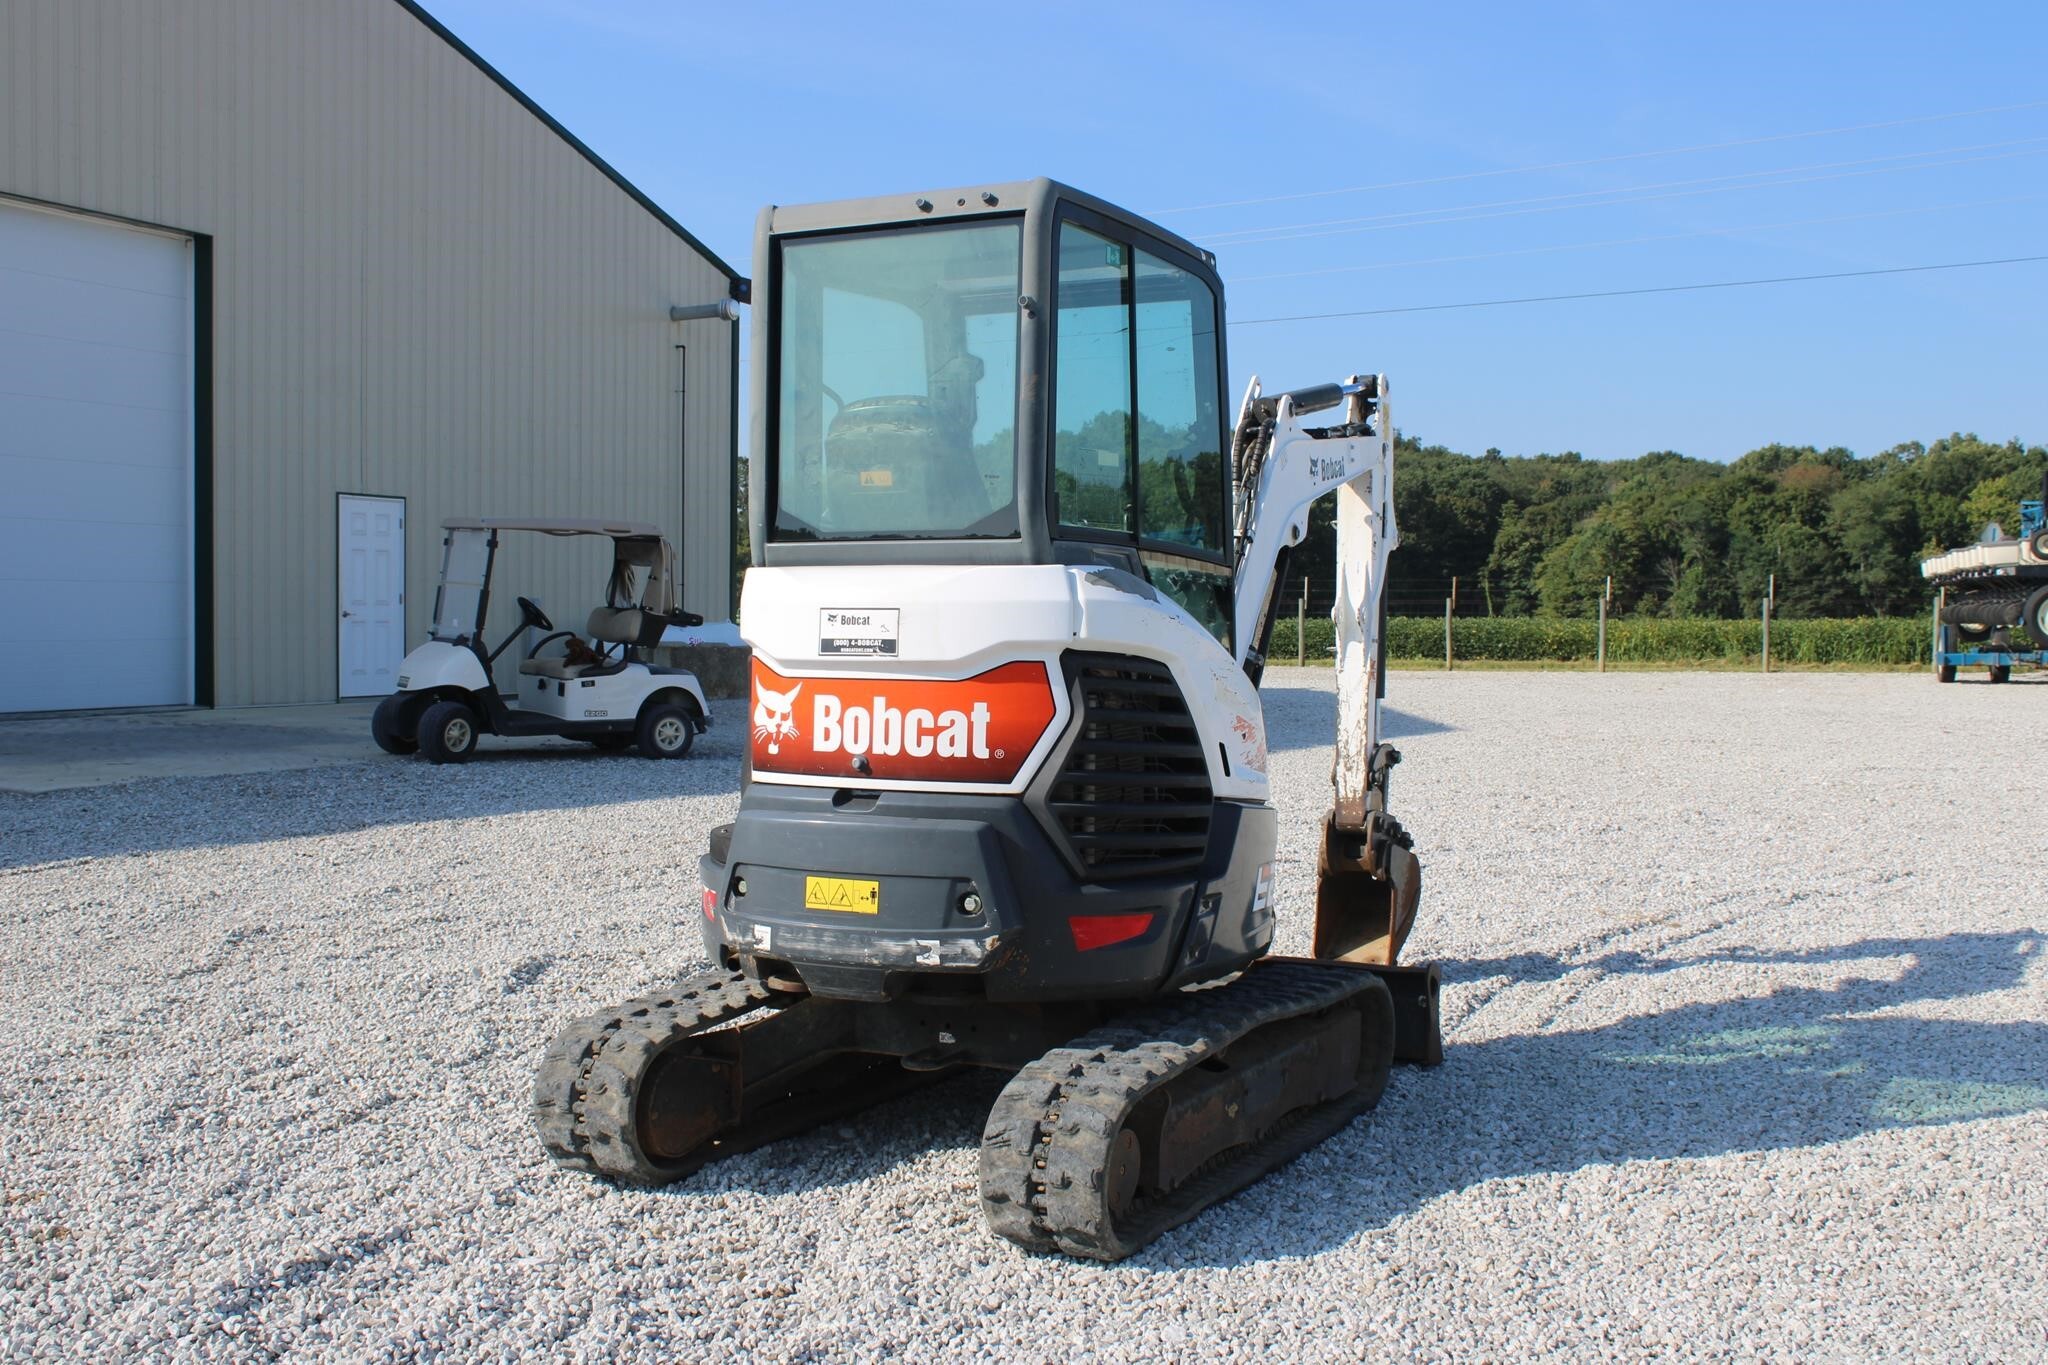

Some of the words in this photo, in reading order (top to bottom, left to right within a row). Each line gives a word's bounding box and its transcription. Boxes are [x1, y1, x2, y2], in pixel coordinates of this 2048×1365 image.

[1321, 455, 1345, 481] Bobcat
[841, 614, 871, 626] Bobcat
[812, 694, 991, 759] Bobcat
